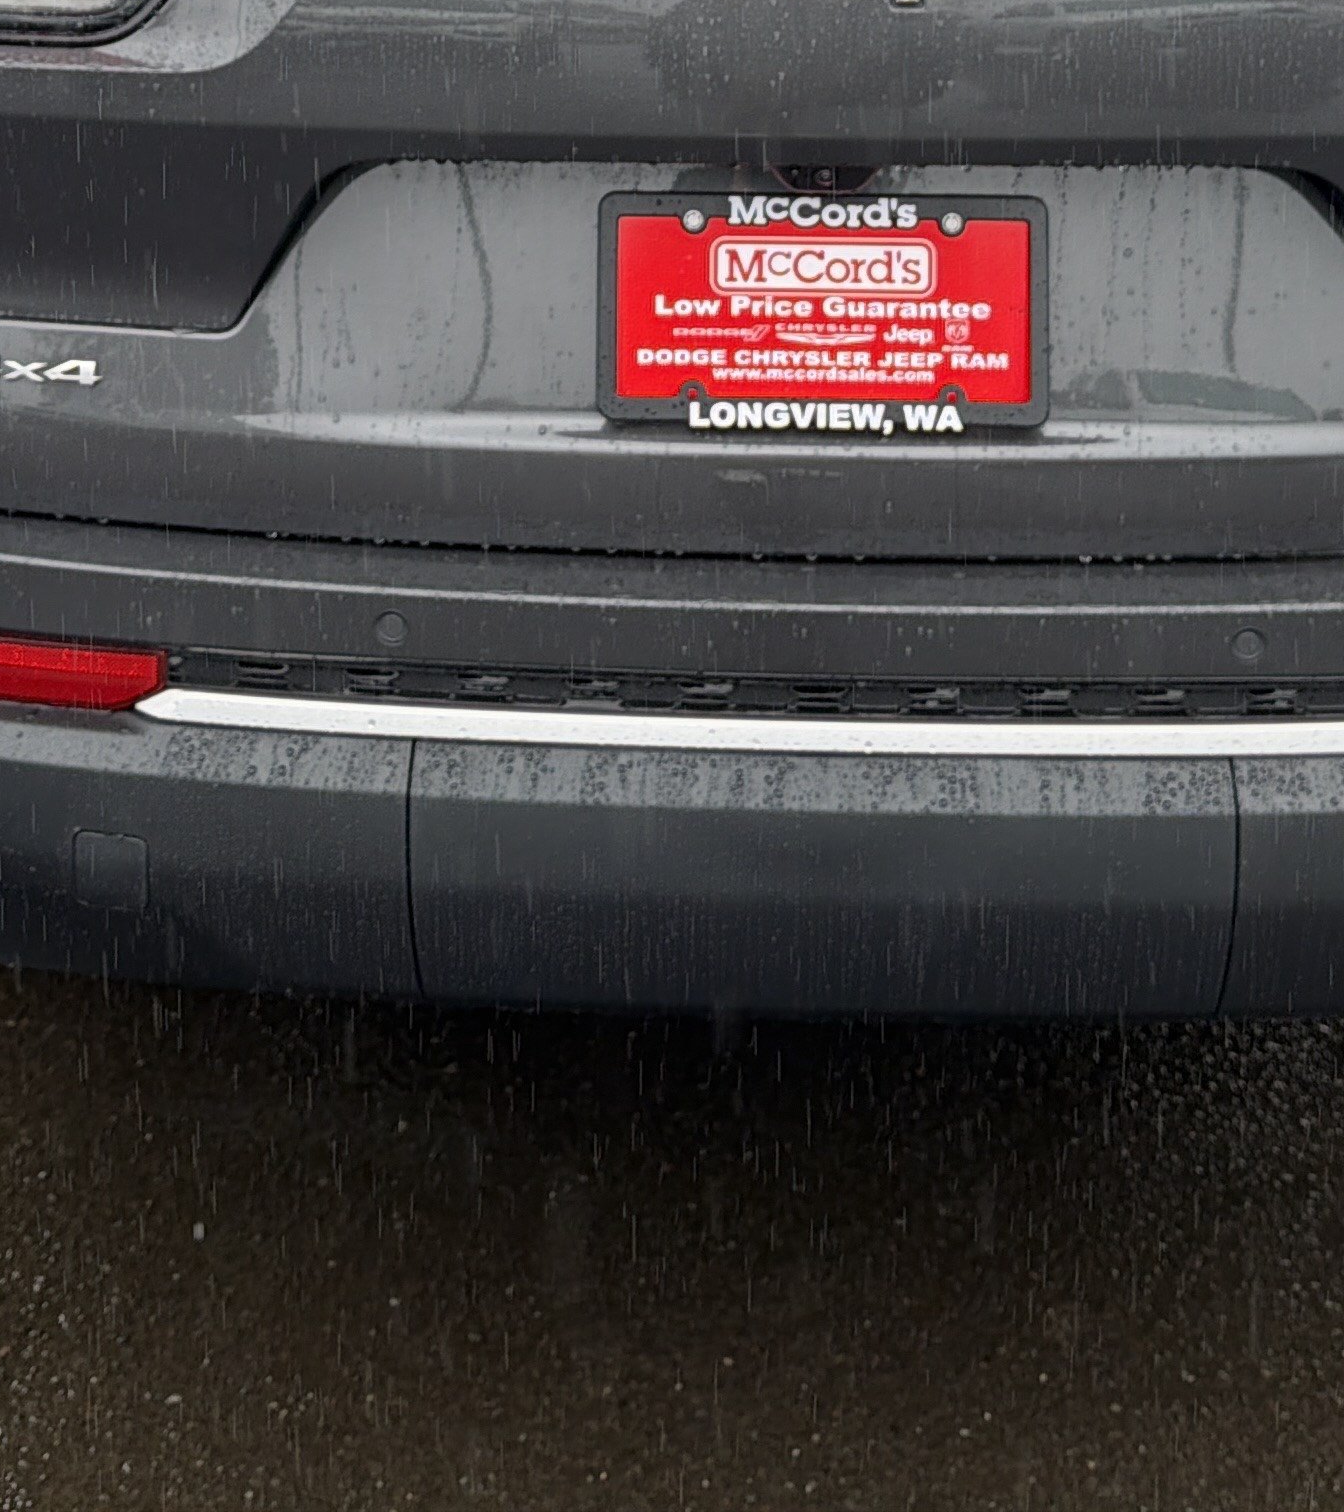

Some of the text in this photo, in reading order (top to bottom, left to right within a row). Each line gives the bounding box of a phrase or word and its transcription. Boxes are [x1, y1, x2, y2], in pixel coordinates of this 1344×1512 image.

[728, 195, 919, 230] McCord's
[724, 248, 922, 286] McCord's
[654, 294, 993, 322] Low Price Guarantee
[882, 323, 936, 346] Jeep
[636, 348, 1010, 370] DODGE CHRYSLER JEEP RAM
[711, 367, 936, 385] www.mccordsales.com
[689, 402, 964, 436] LONGVIEW, WA
